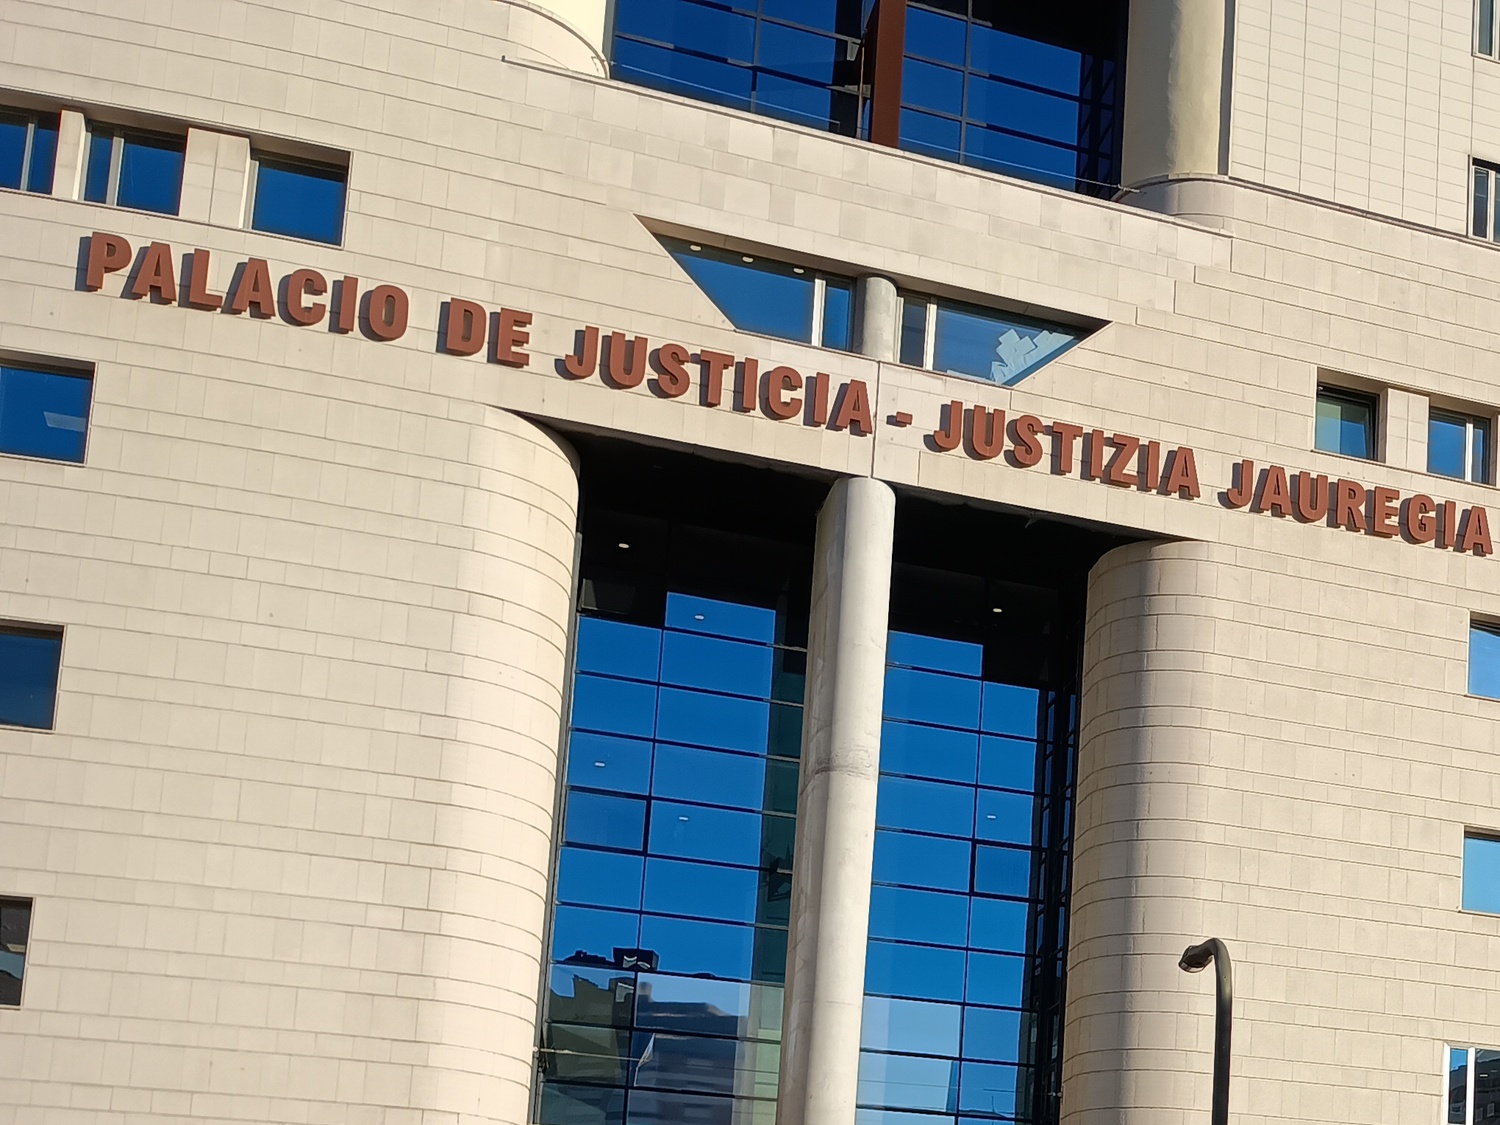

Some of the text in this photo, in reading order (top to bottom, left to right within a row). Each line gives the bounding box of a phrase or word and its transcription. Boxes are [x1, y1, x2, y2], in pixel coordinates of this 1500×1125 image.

[80, 231, 410, 341] PALACIO
[442, 297, 533, 367] DE
[560, 326, 873, 434] JUSTICIA
[934, 401, 1200, 500] JUSTIZIA
[1223, 458, 1493, 556] JAUREGIA
